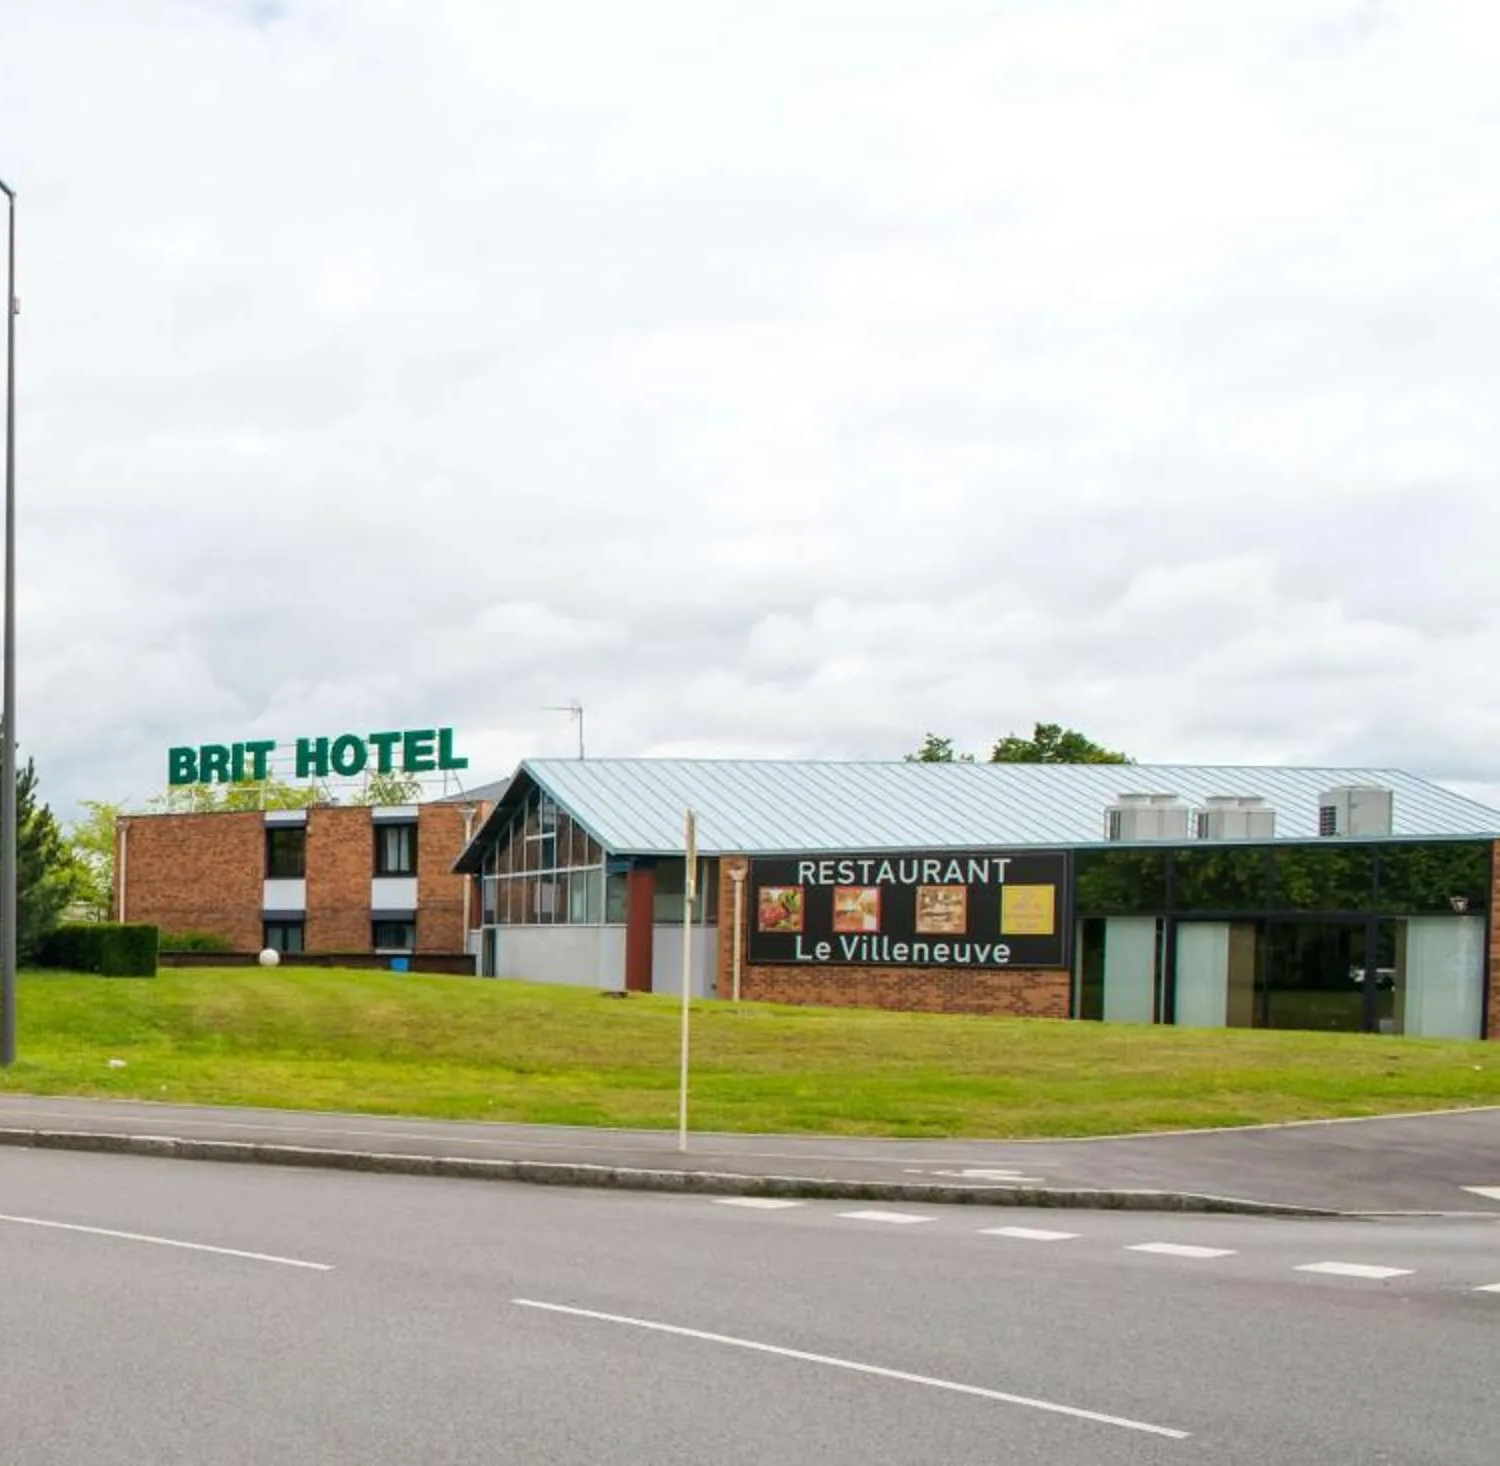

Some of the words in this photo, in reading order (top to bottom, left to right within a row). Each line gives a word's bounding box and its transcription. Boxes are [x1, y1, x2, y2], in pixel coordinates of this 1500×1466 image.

[168, 740, 275, 785] BRIT
[296, 728, 468, 779] HOTEL
[798, 858, 1012, 885] RESTAURANT
[796, 936, 831, 960] Le
[839, 935, 1011, 963] Villeneuve
